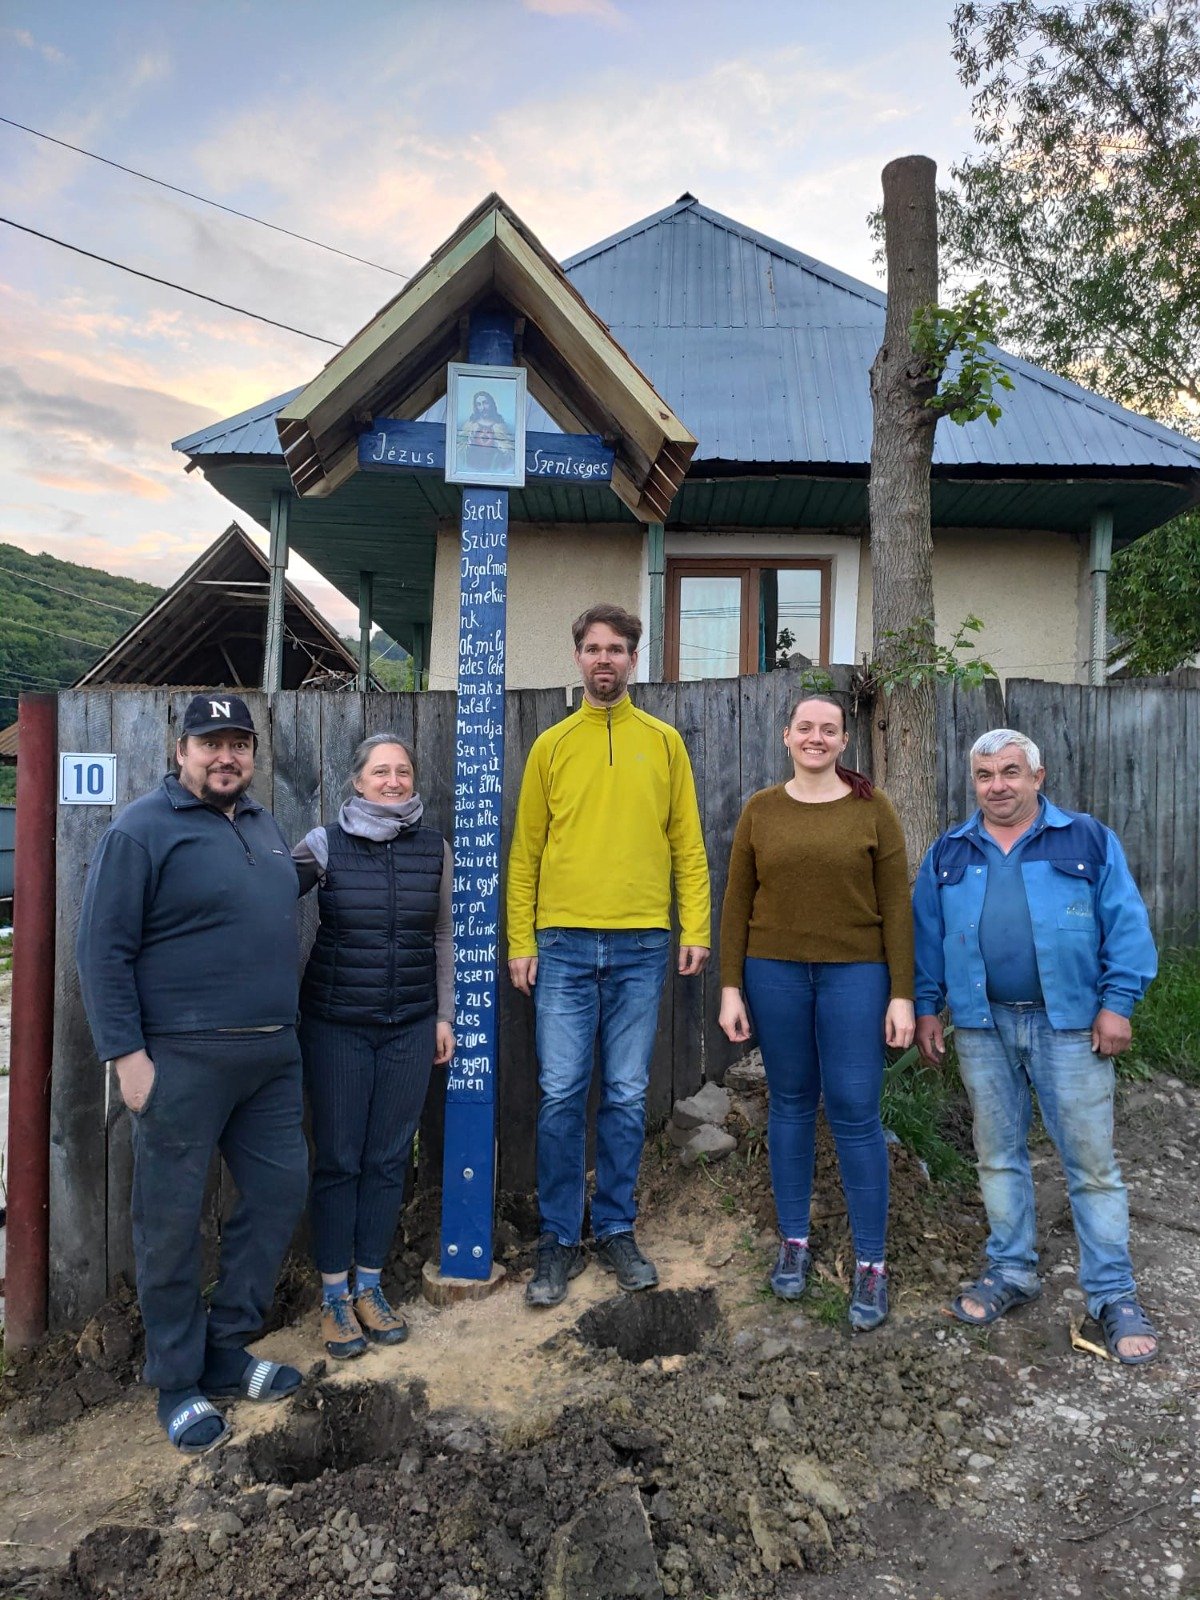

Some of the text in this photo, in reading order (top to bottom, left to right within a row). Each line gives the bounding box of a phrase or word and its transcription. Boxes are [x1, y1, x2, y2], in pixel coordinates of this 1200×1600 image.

[373, 432, 608, 478] Jézus Szentséges
[463, 499, 503, 521] Szent
[462, 530, 507, 552] Szüve
[459, 657, 484, 676] édes
[209, 701, 231, 718] N
[457, 718, 503, 739] Mondja
[456, 740, 496, 757] Szent
[74, 764, 104, 795] 10
[455, 781, 474, 795] aki
[453, 990, 492, 1008] ézus
[455, 1009, 481, 1027] des
